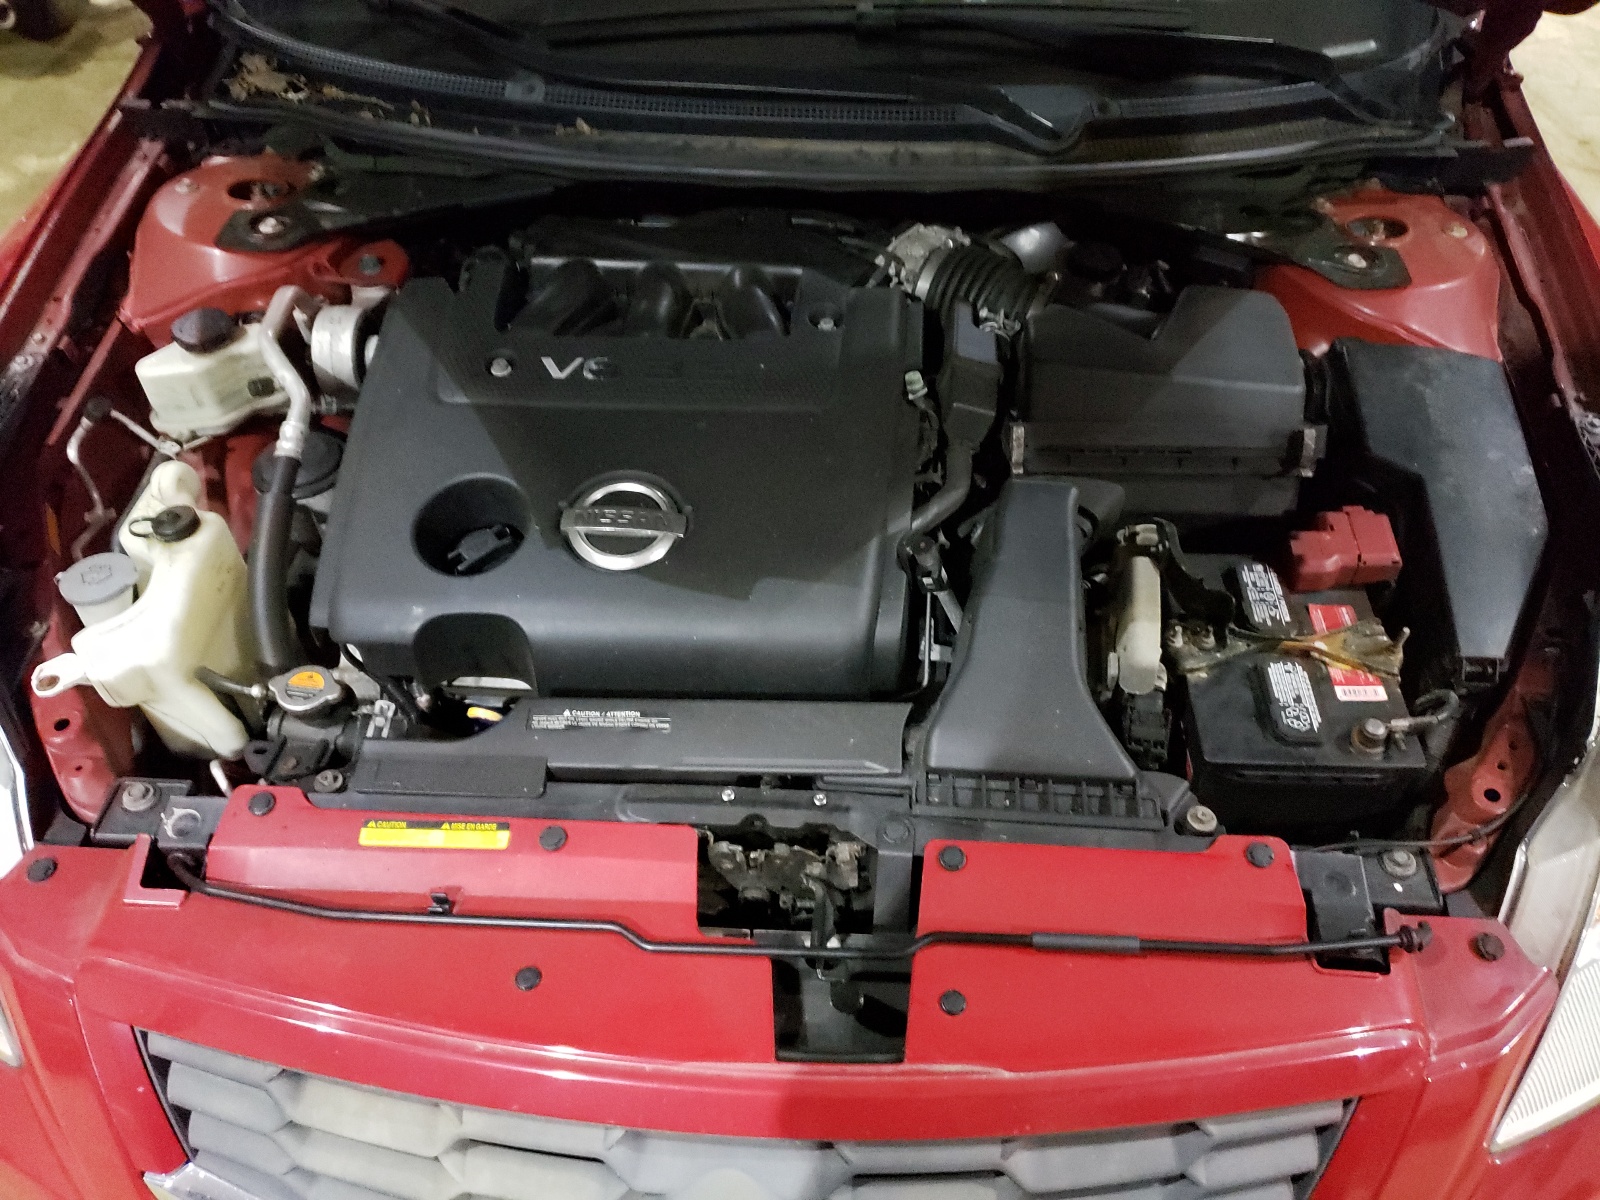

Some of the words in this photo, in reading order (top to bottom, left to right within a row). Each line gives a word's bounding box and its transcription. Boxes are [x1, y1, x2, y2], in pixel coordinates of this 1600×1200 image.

[540, 356, 610, 380] V6
[575, 508, 669, 526] NISSAN
[571, 709, 600, 718] CAUTION
[605, 710, 641, 718] ATTENTION
[376, 820, 407, 829] CAUTION
[451, 822, 466, 830] MISE
[466, 822, 475, 830] EN
[475, 823, 498, 831] GARDE
